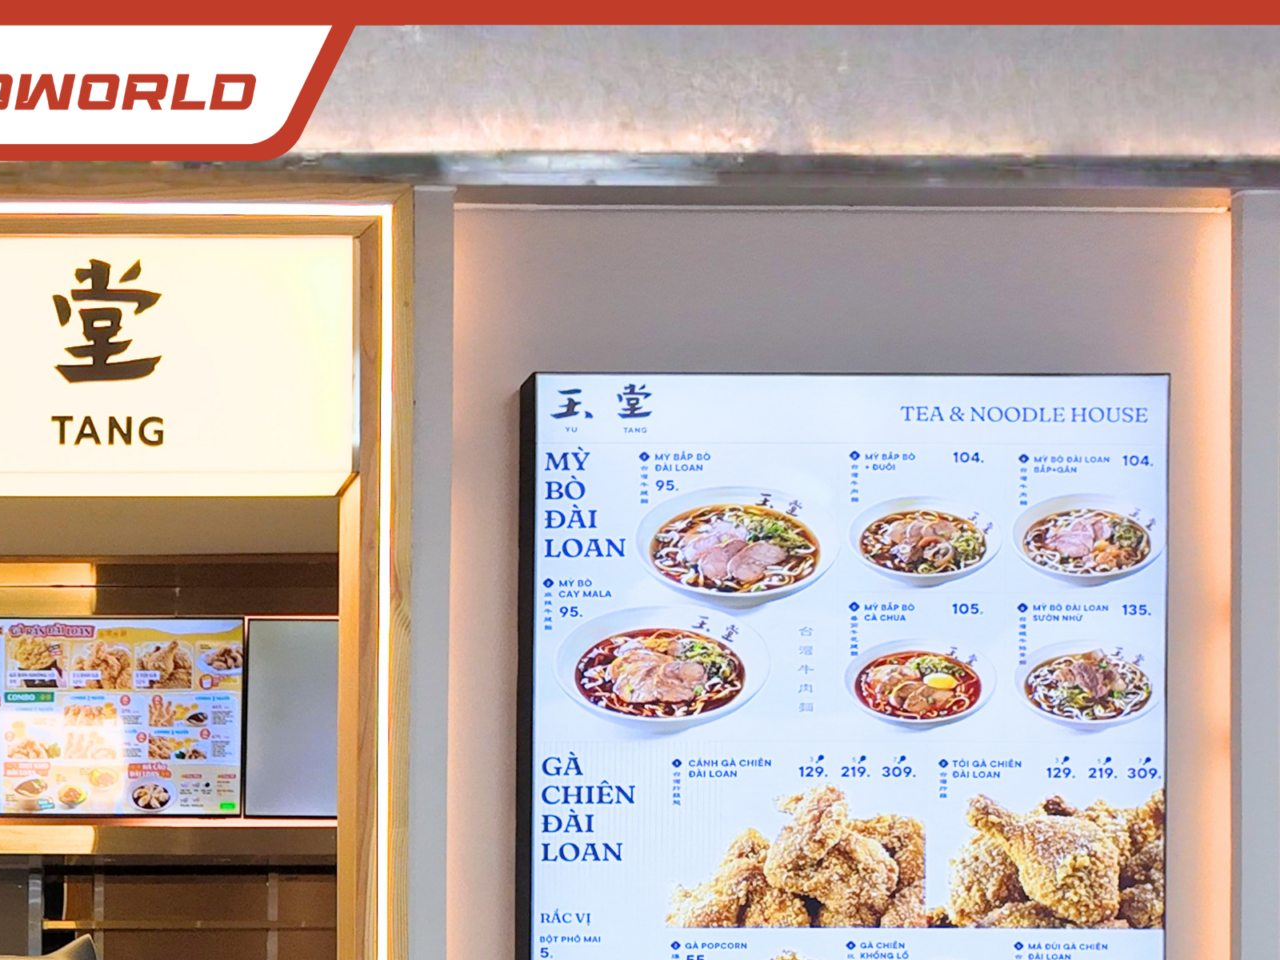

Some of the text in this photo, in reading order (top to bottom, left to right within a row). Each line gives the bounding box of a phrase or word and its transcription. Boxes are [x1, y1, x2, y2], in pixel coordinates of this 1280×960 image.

[52, 258, 162, 384] 堂
[550, 384, 652, 419] 玉 堂
[900, 406, 1148, 423] TEA & NOODLE HOUSE
[51, 416, 164, 447] TANG
[564, 426, 648, 434] YU TANG
[545, 446, 590, 471] MỲ
[674, 463, 704, 472] LOAN
[545, 475, 585, 500] BÒ
[655, 479, 679, 492] 95.
[545, 504, 597, 529] ĐÀI
[545, 539, 626, 558] LOAN
[558, 589, 612, 599] CAY MALA
[559, 605, 583, 618] 95.
[1121, 603, 1152, 616] 135.
[879, 613, 907, 622] CHUA
[542, 752, 583, 776] GÀ
[708, 769, 738, 778] LOAN
[972, 770, 1001, 779] LOAN
[542, 780, 635, 805] CHIÊN
[542, 809, 594, 833] ĐÀI
[541, 843, 622, 862] LOAN
[576, 913, 590, 926] VỊ
[583, 935, 602, 943] MAI
[700, 942, 748, 950] POPCORN
[1045, 953, 1072, 960] LOAN
